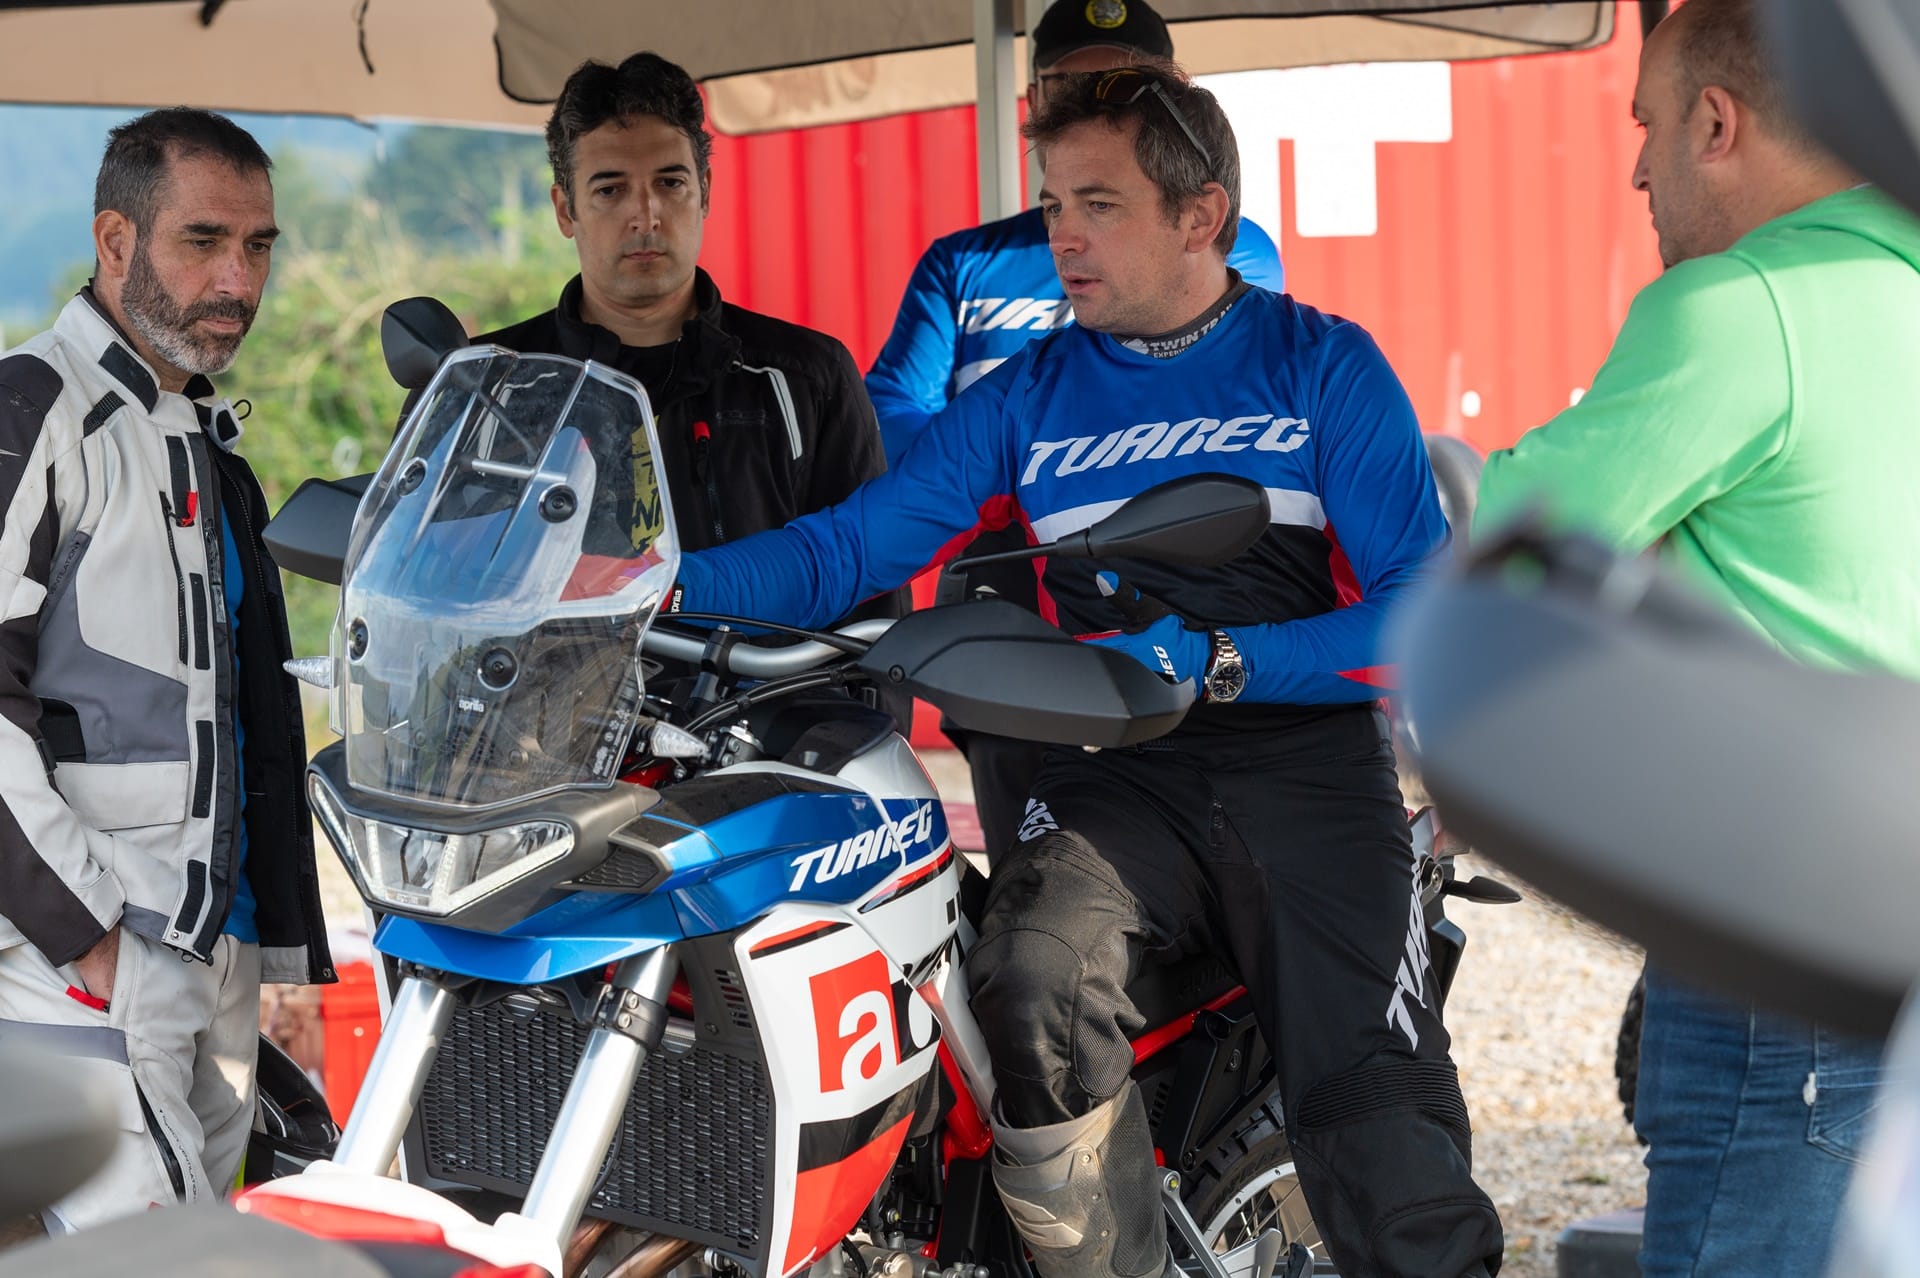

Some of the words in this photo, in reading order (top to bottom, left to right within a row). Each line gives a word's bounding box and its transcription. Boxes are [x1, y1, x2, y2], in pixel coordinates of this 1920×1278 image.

[1150, 330, 1199, 352] TWIN
[1020, 414, 1310, 487] TUAREG
[788, 799, 933, 893] TUAREG
